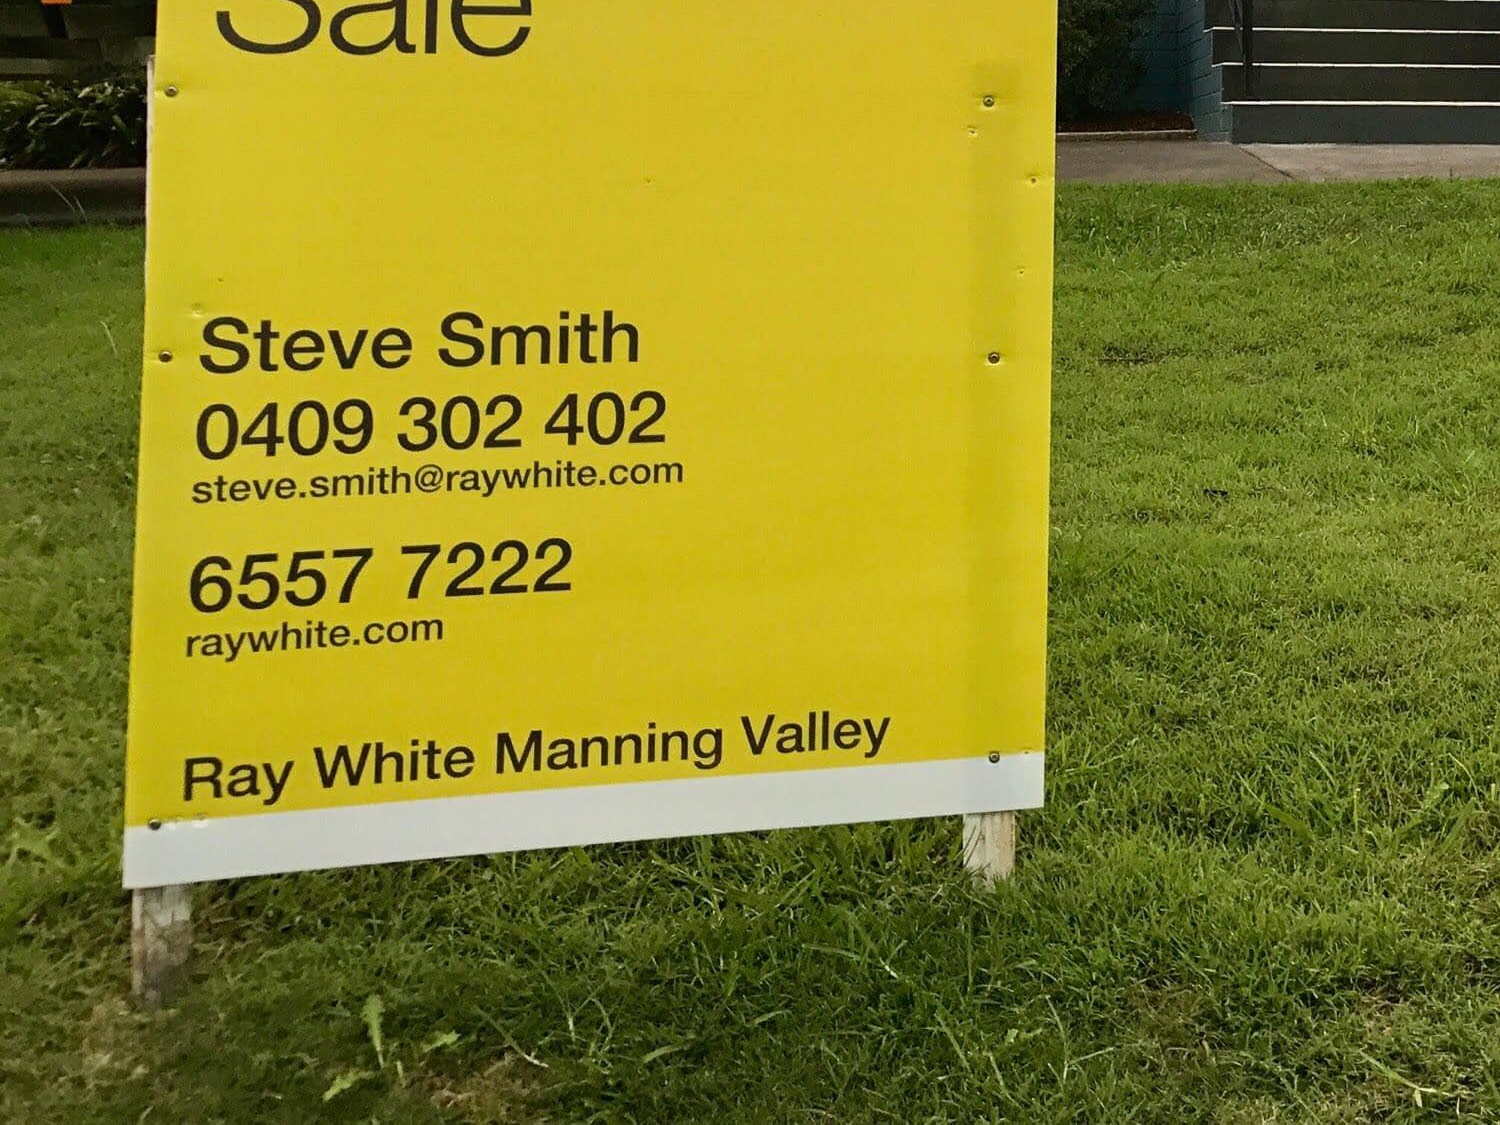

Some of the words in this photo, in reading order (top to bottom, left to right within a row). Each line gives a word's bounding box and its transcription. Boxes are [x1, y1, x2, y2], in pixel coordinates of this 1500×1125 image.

[200, 316, 412, 375] Steve
[438, 310, 640, 367] Smith
[197, 398, 374, 461] 0409
[396, 393, 523, 452] 302
[544, 390, 667, 446] 402
[191, 459, 685, 505] steve.smith@raywhite.com
[189, 547, 373, 614] 6557
[401, 537, 573, 599] 7222
[186, 618, 444, 662] raywhite.com
[182, 755, 294, 805] Ray
[313, 738, 475, 792] White
[494, 721, 724, 775] Manning
[740, 710, 892, 758] Valley
